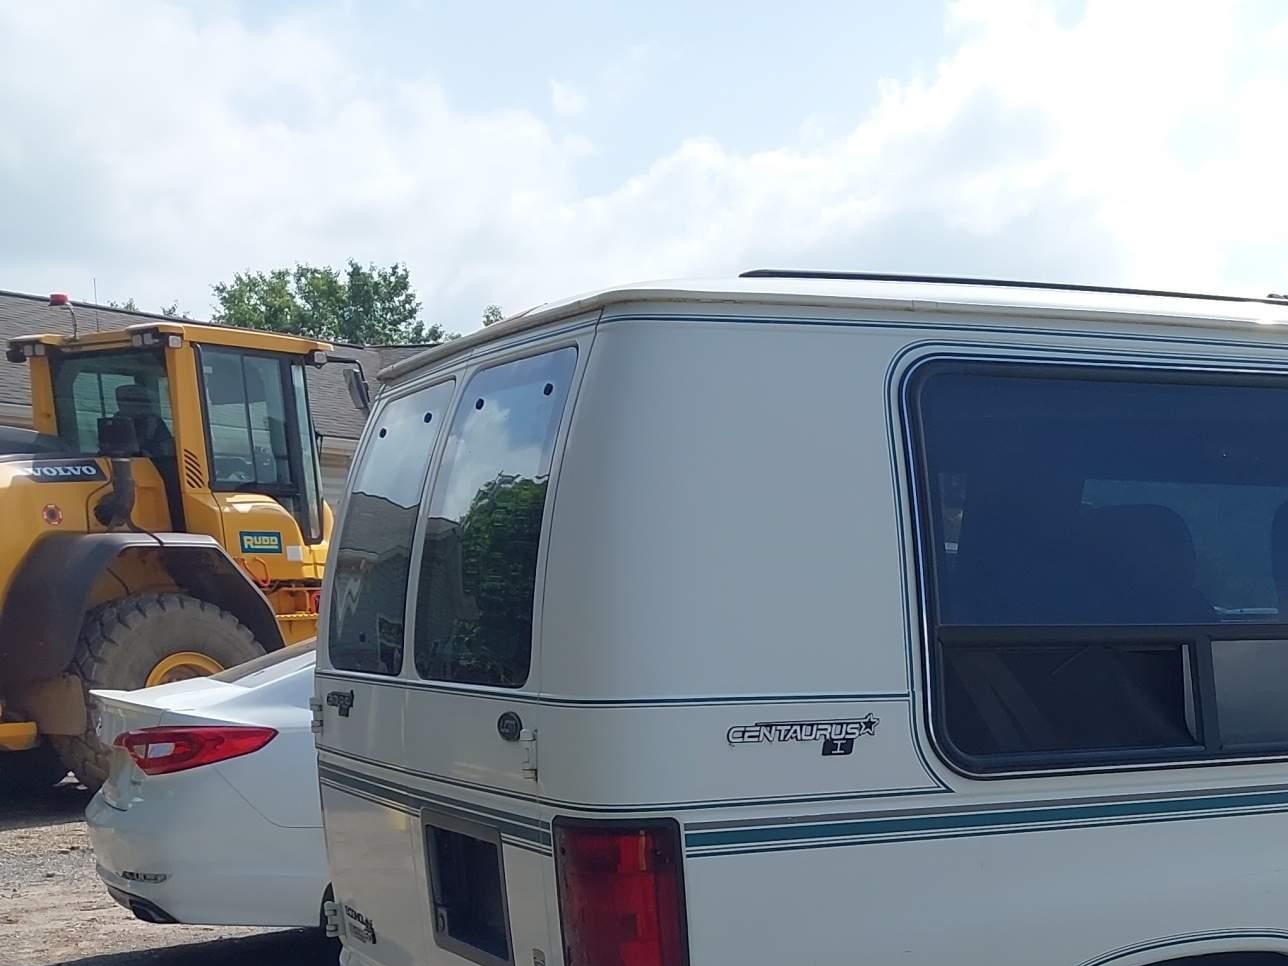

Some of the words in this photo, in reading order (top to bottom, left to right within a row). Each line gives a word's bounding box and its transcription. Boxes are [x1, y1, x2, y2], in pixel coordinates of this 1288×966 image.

[26, 465, 97, 477] VOLVO
[243, 535, 279, 549] RUDD
[727, 721, 861, 744] CENTAURUS
